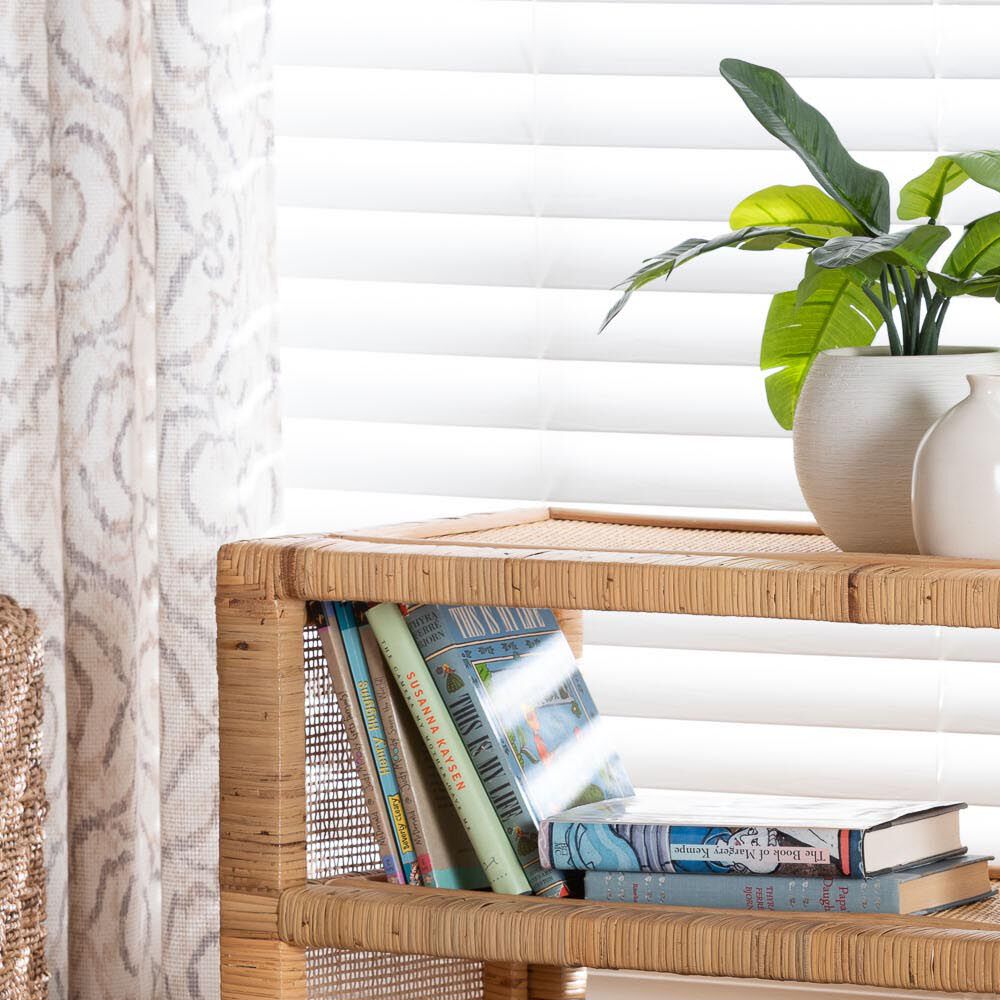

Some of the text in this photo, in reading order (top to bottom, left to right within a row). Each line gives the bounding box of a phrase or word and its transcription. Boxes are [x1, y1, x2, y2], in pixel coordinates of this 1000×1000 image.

[382, 640, 392, 659] THE
[448, 605, 546, 639] THIS IS MY LIFE
[358, 680, 391, 776] Henry Huggins
[406, 671, 466, 791] SUSANNA KAYSEN
[448, 692, 524, 823] THIS IS MY LIFE
[674, 846, 826, 862] The Book of Margery Kempe
